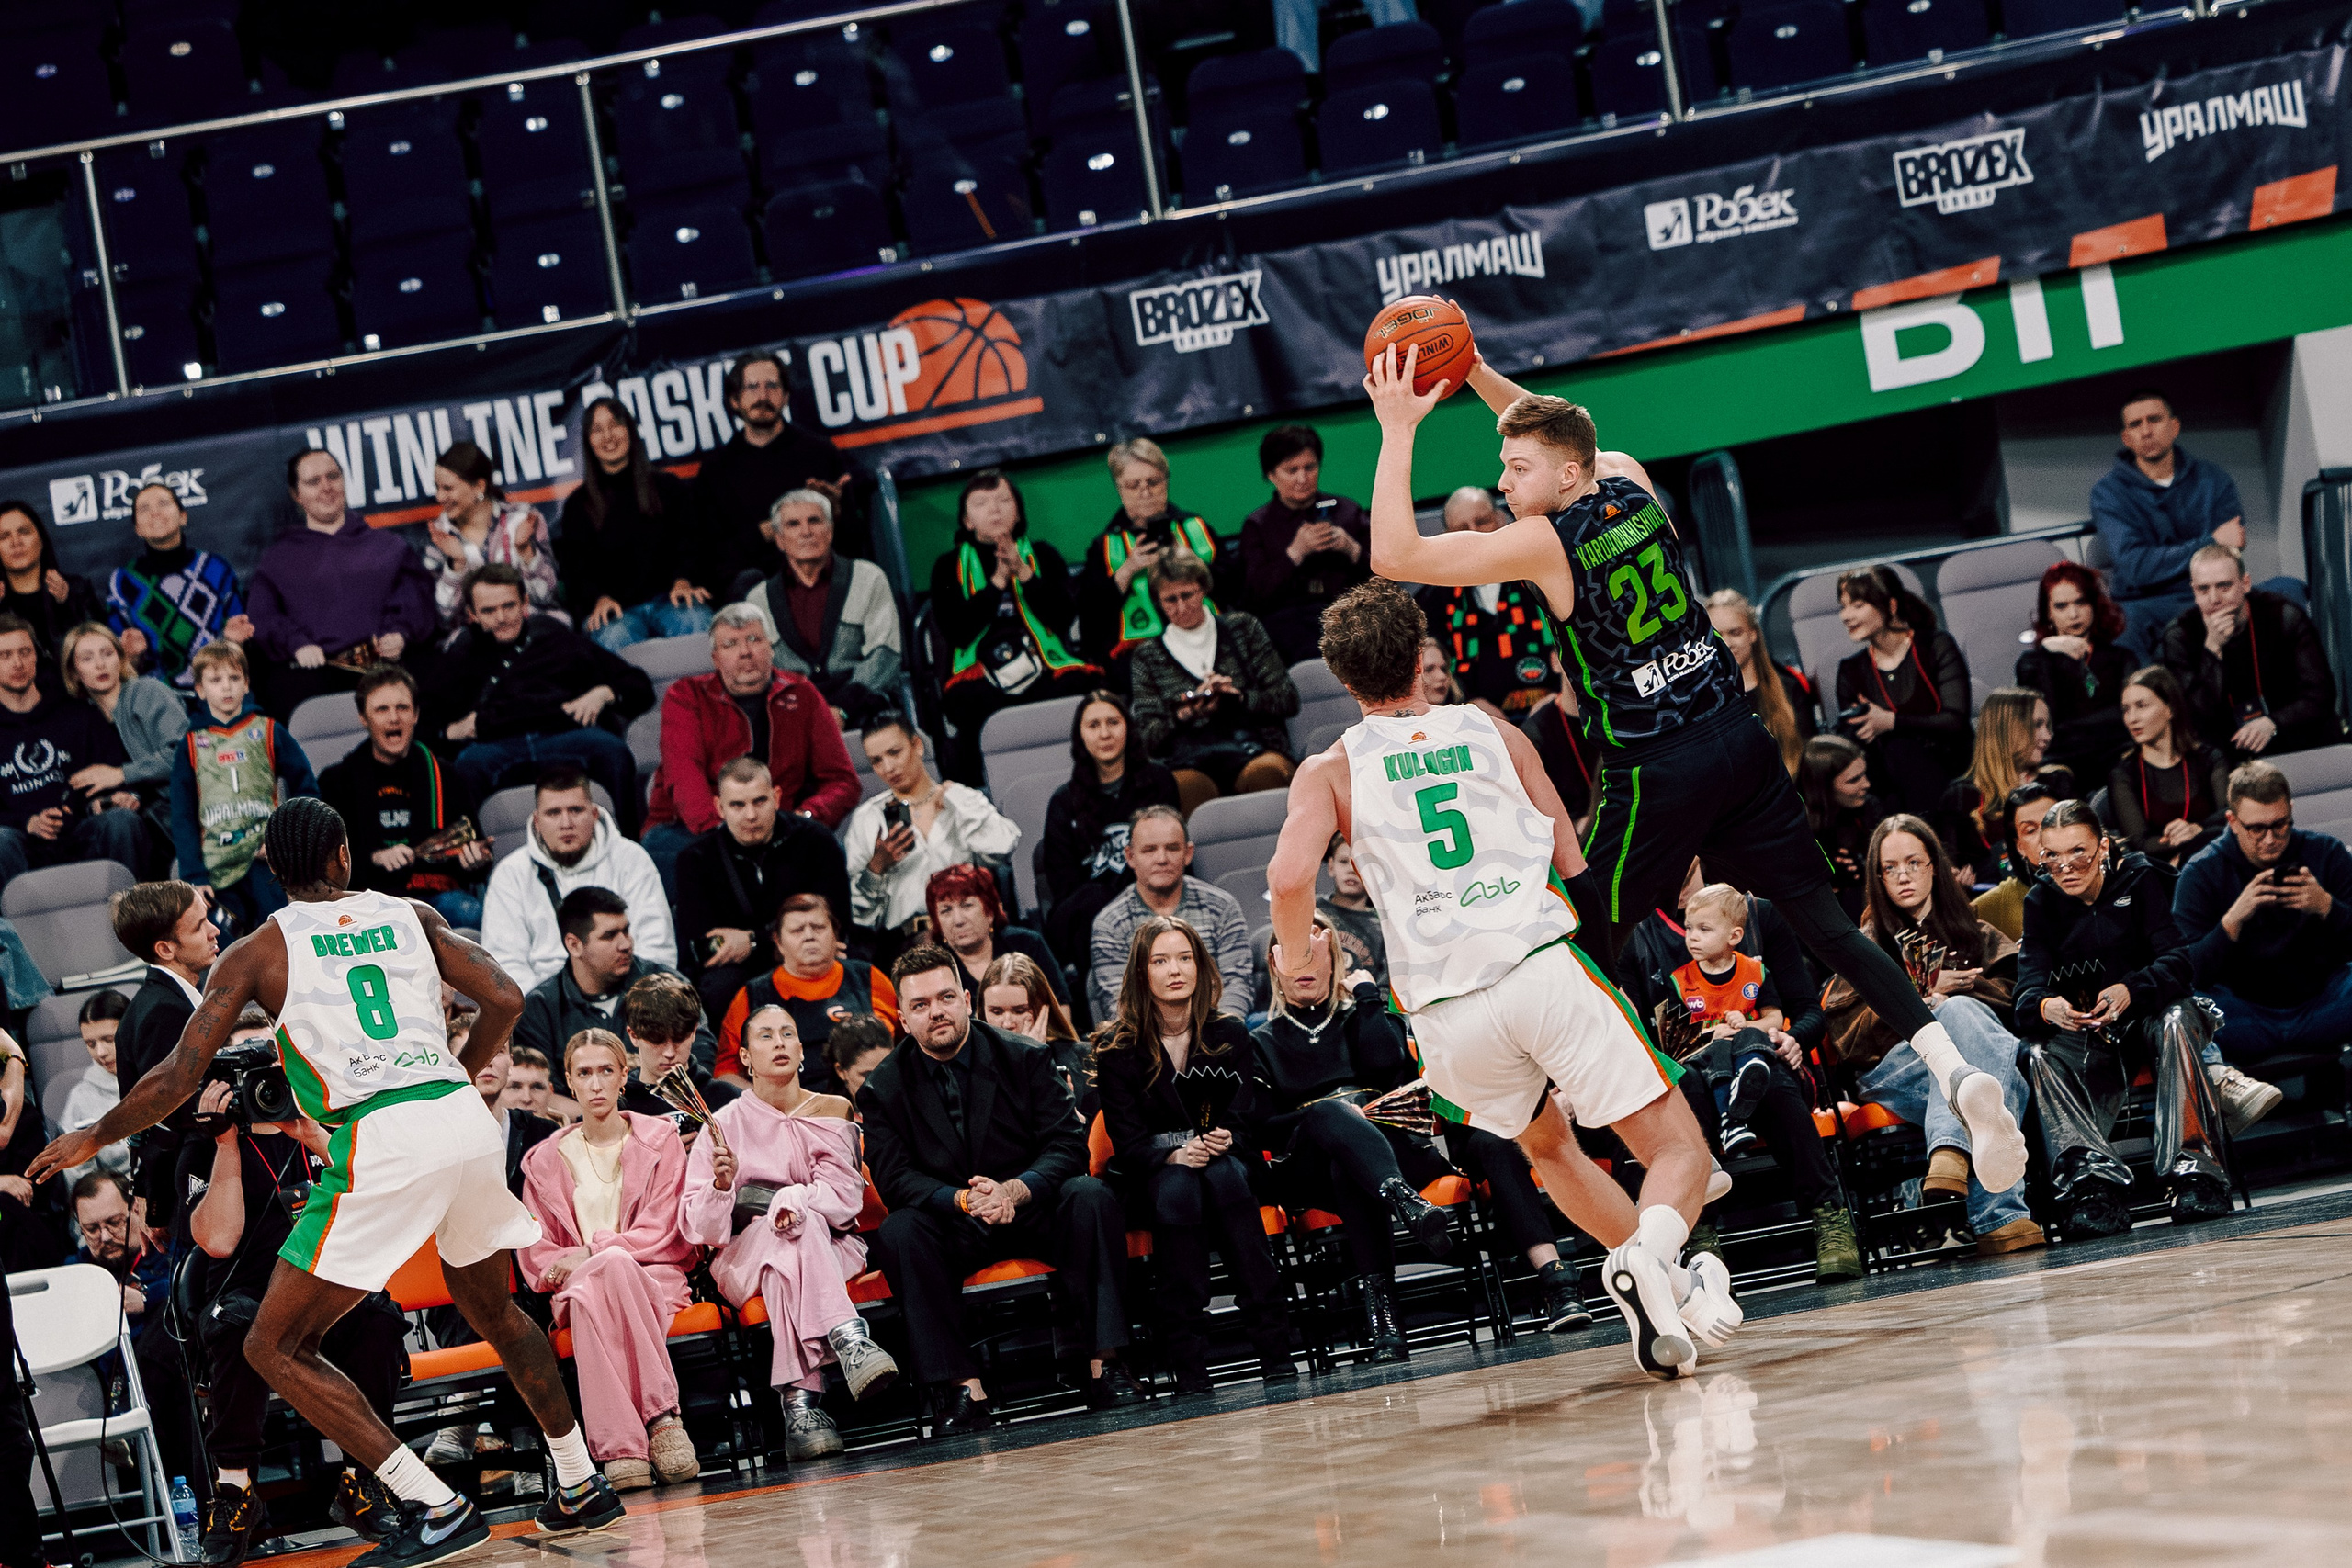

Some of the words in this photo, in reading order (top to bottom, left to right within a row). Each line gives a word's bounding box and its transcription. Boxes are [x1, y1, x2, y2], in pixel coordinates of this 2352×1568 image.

[2139, 79, 2308, 163] УРАЛМАШ
[1896, 135, 2028, 201] BROZEX
[1692, 184, 1799, 231] Робек
[1376, 231, 1546, 306] УРАЛМАШ
[1134, 276, 1264, 340] BROZEX
[808, 326, 922, 429] CUP
[1609, 542, 1688, 645] 23
[1383, 745, 1474, 782] KULAGIN
[1415, 782, 1475, 871] 5
[311, 925, 398, 958] BREWER
[346, 964, 399, 1041] 8
[353, 1062, 380, 1077] Банк
